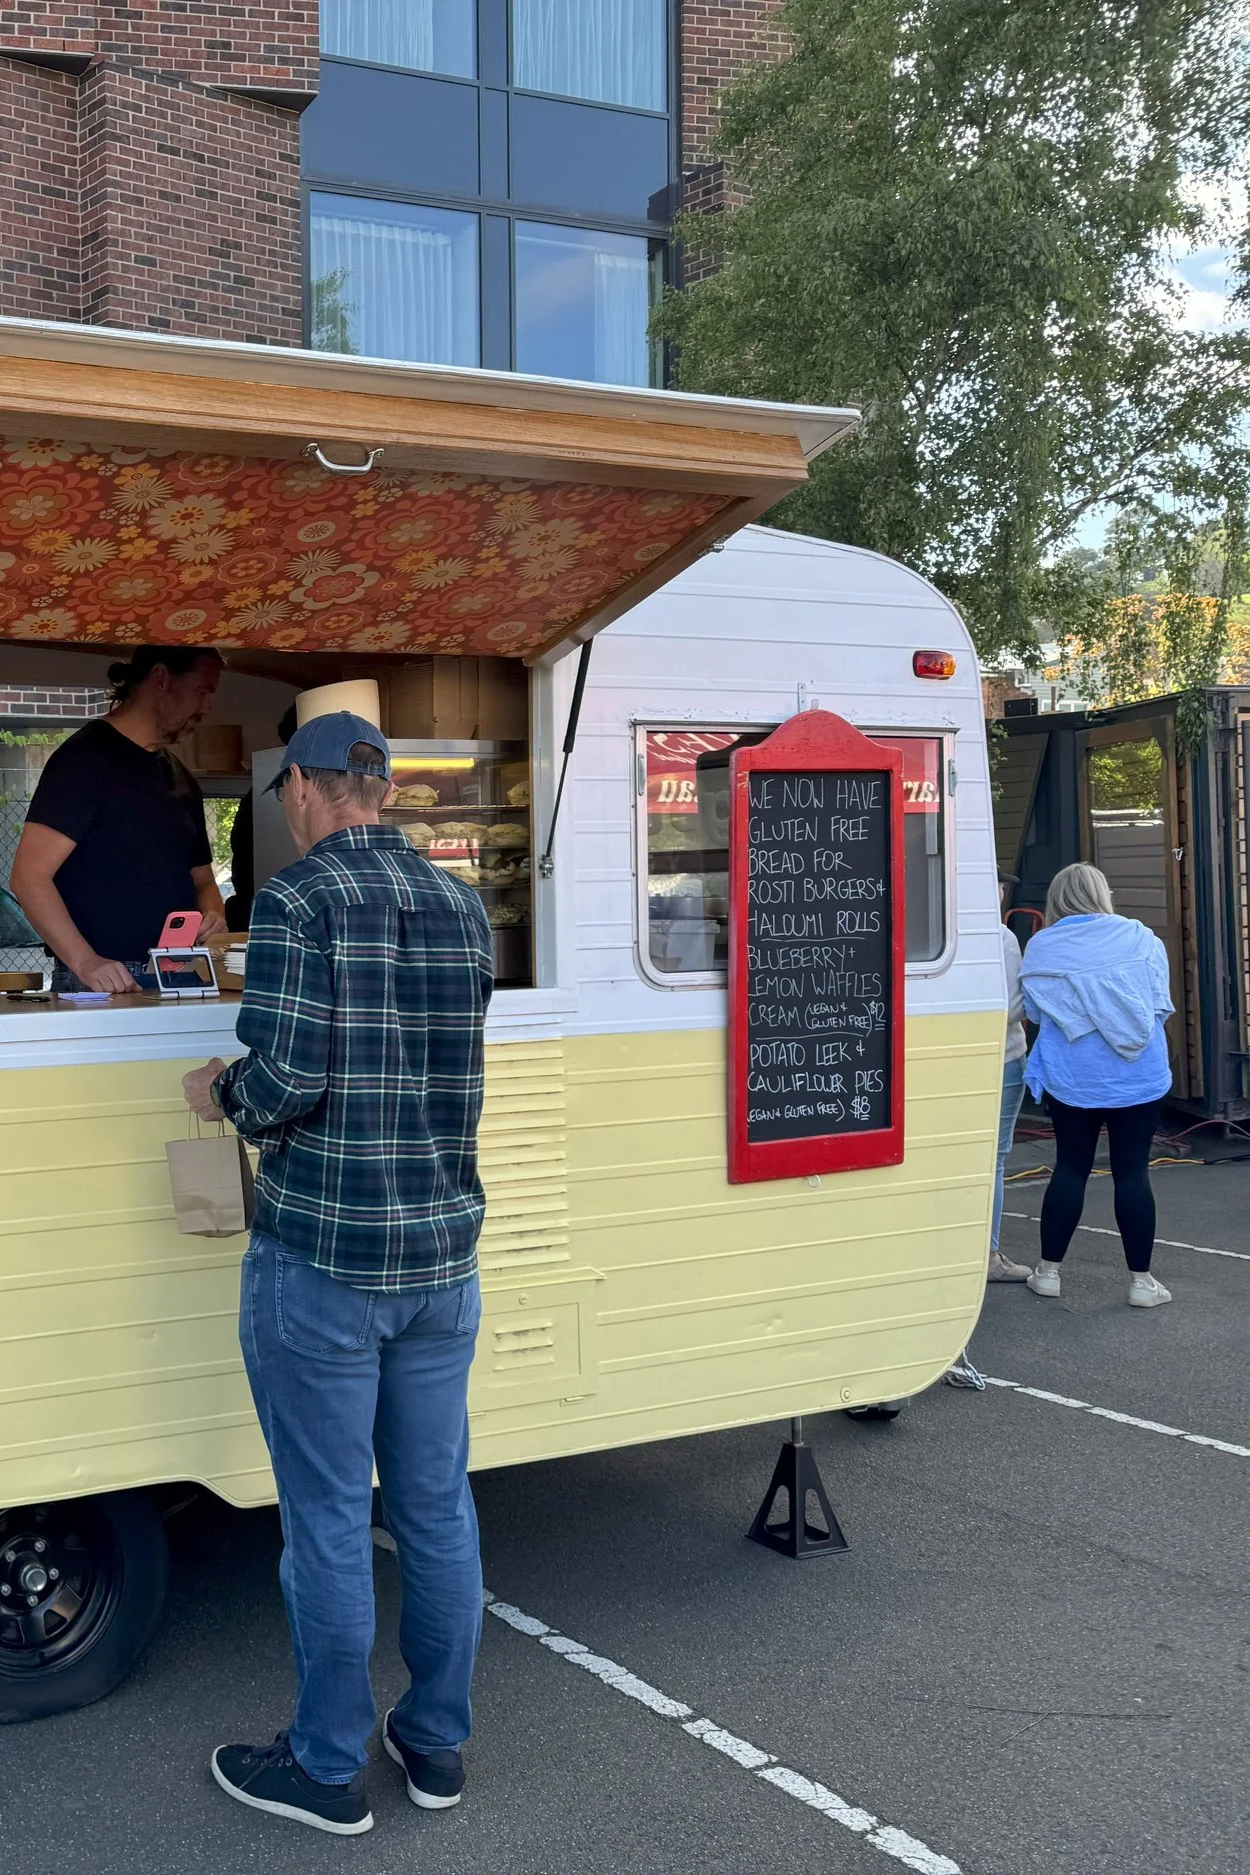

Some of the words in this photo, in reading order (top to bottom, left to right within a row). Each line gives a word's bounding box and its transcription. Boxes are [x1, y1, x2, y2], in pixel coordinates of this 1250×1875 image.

[749, 779, 774, 808] WE
[783, 778, 823, 808] NOW
[837, 780, 882, 810] HAVE
[749, 816, 818, 843] GLUTEN
[831, 816, 870, 842] FREE
[748, 848, 805, 876] BREAD
[814, 848, 852, 872] FOR
[748, 880, 794, 903] ROSTI
[837, 911, 880, 935] ROLLS
[748, 974, 805, 998] LEMON
[811, 969, 882, 997] WAFFLES
[749, 1002, 801, 1028] CREAM
[811, 1016, 846, 1029] GLUTEN
[870, 1000, 886, 1022] $12
[751, 1041, 805, 1068] POTATO
[816, 1042, 852, 1066] LEEK
[748, 1072, 848, 1093] CAULIFLOWER
[855, 1070, 884, 1093] PIES
[784, 1105, 814, 1118] GLUTEN
[850, 1096, 870, 1119] $8
